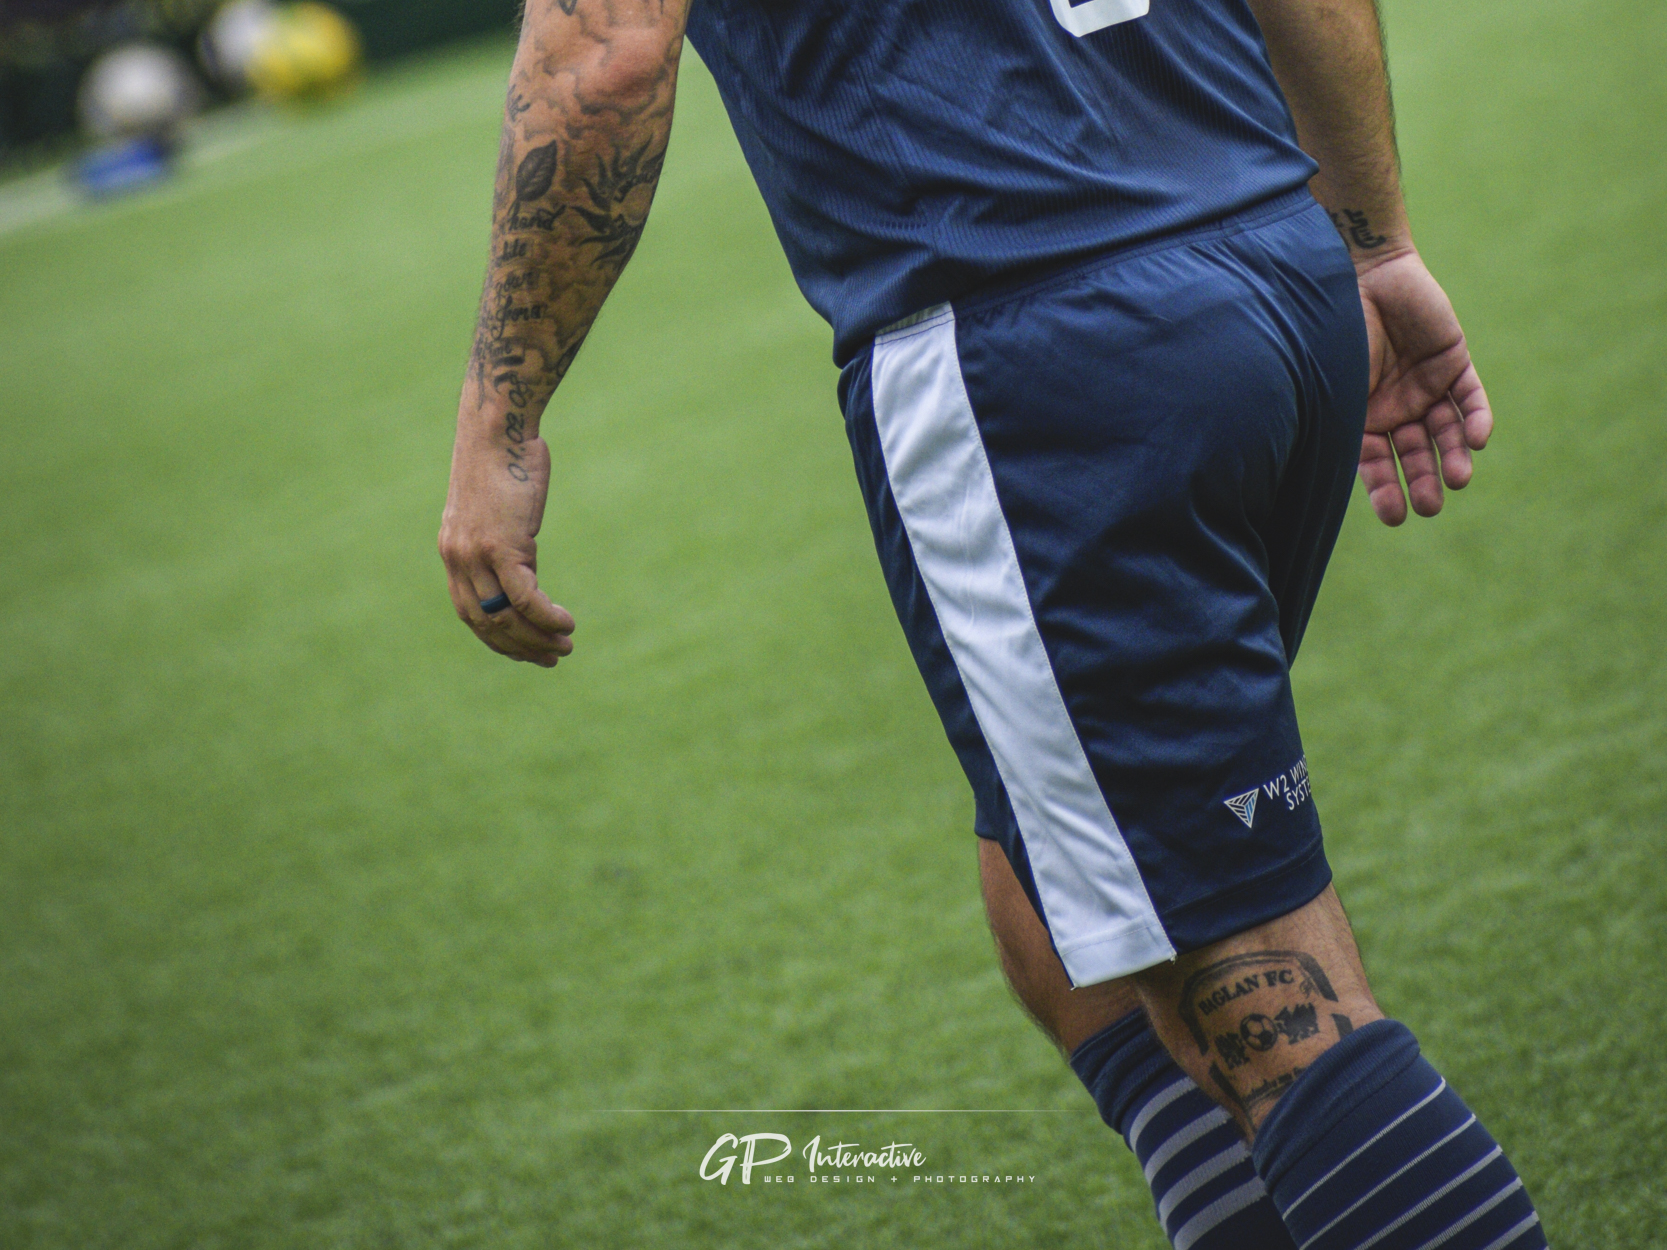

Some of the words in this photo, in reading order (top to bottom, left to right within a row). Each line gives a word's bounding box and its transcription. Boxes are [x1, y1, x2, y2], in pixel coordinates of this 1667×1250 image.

[1262, 774, 1290, 801] W2
[1289, 754, 1308, 785] WIN
[1263, 969, 1295, 988] FC
